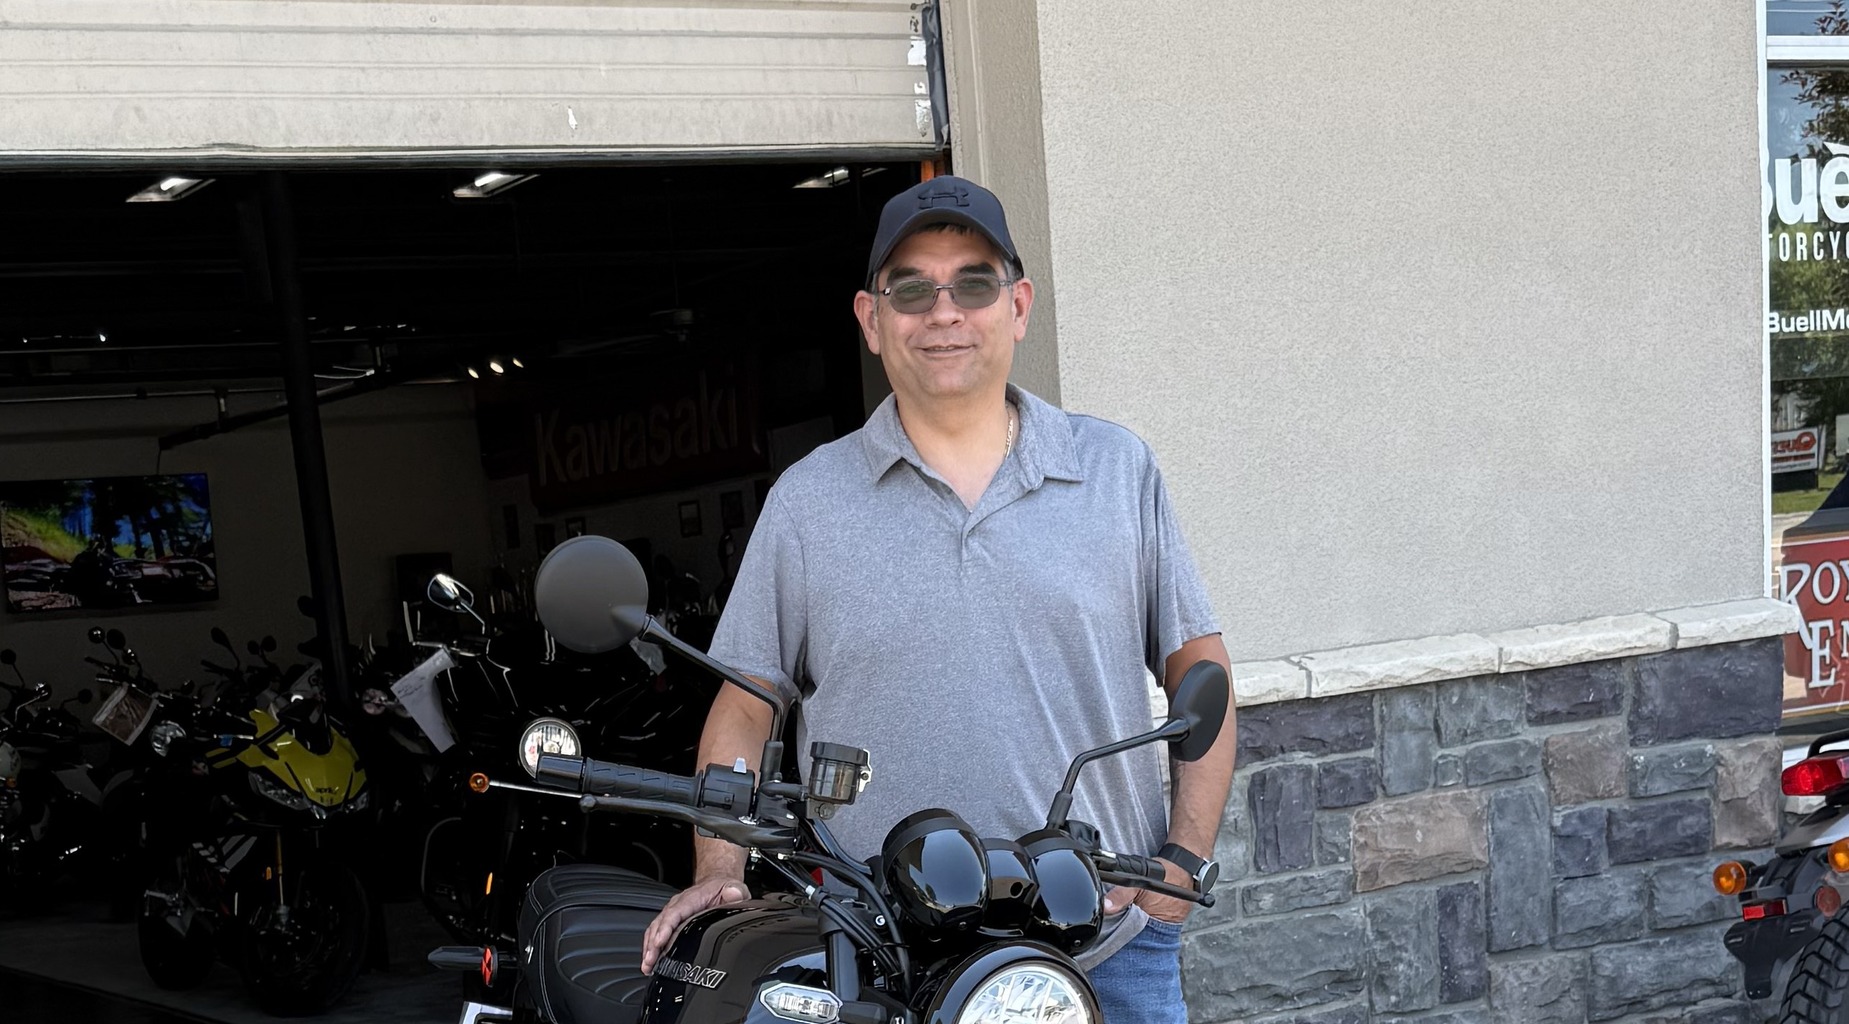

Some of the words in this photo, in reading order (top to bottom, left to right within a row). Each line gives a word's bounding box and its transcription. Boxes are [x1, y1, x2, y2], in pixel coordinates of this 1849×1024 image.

[1768, 157, 1849, 225] ue
[1768, 231, 1849, 262] ORCY
[1769, 308, 1849, 333] BuellM
[534, 363, 741, 488] Kawasaki
